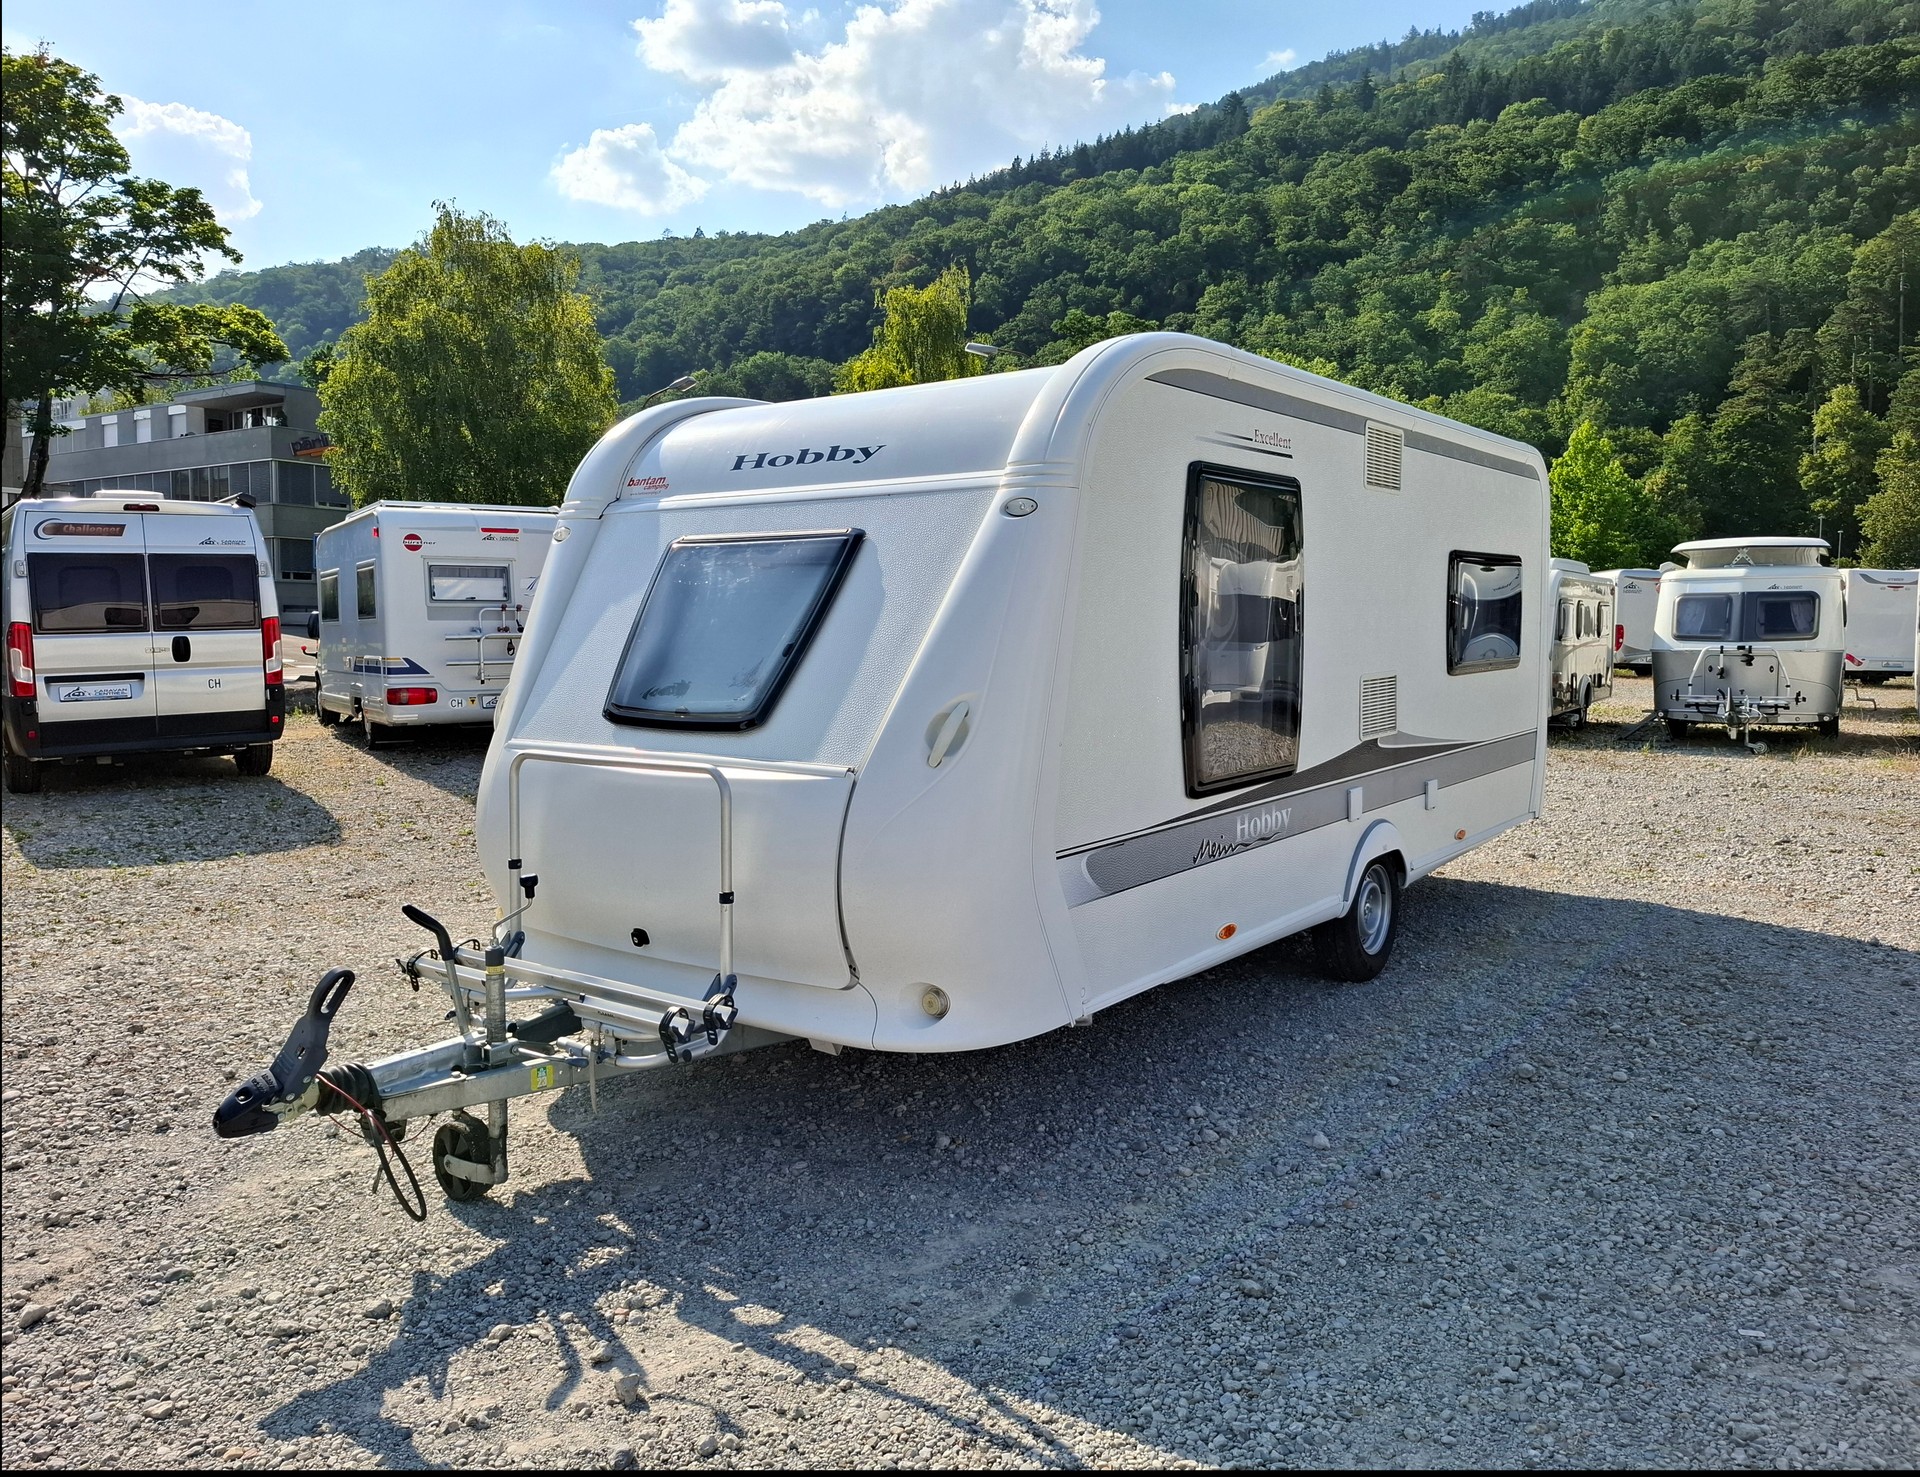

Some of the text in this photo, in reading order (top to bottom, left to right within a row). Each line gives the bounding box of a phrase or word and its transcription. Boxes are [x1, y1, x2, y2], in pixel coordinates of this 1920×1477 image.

[1254, 429, 1292, 449] Excellent
[729, 444, 887, 471] Hobby
[627, 476, 666, 487] bantam
[63, 524, 120, 535] Challenger
[208, 678, 221, 689] CH
[450, 699, 463, 708] CH
[1193, 804, 1292, 864] Mein Hobby
